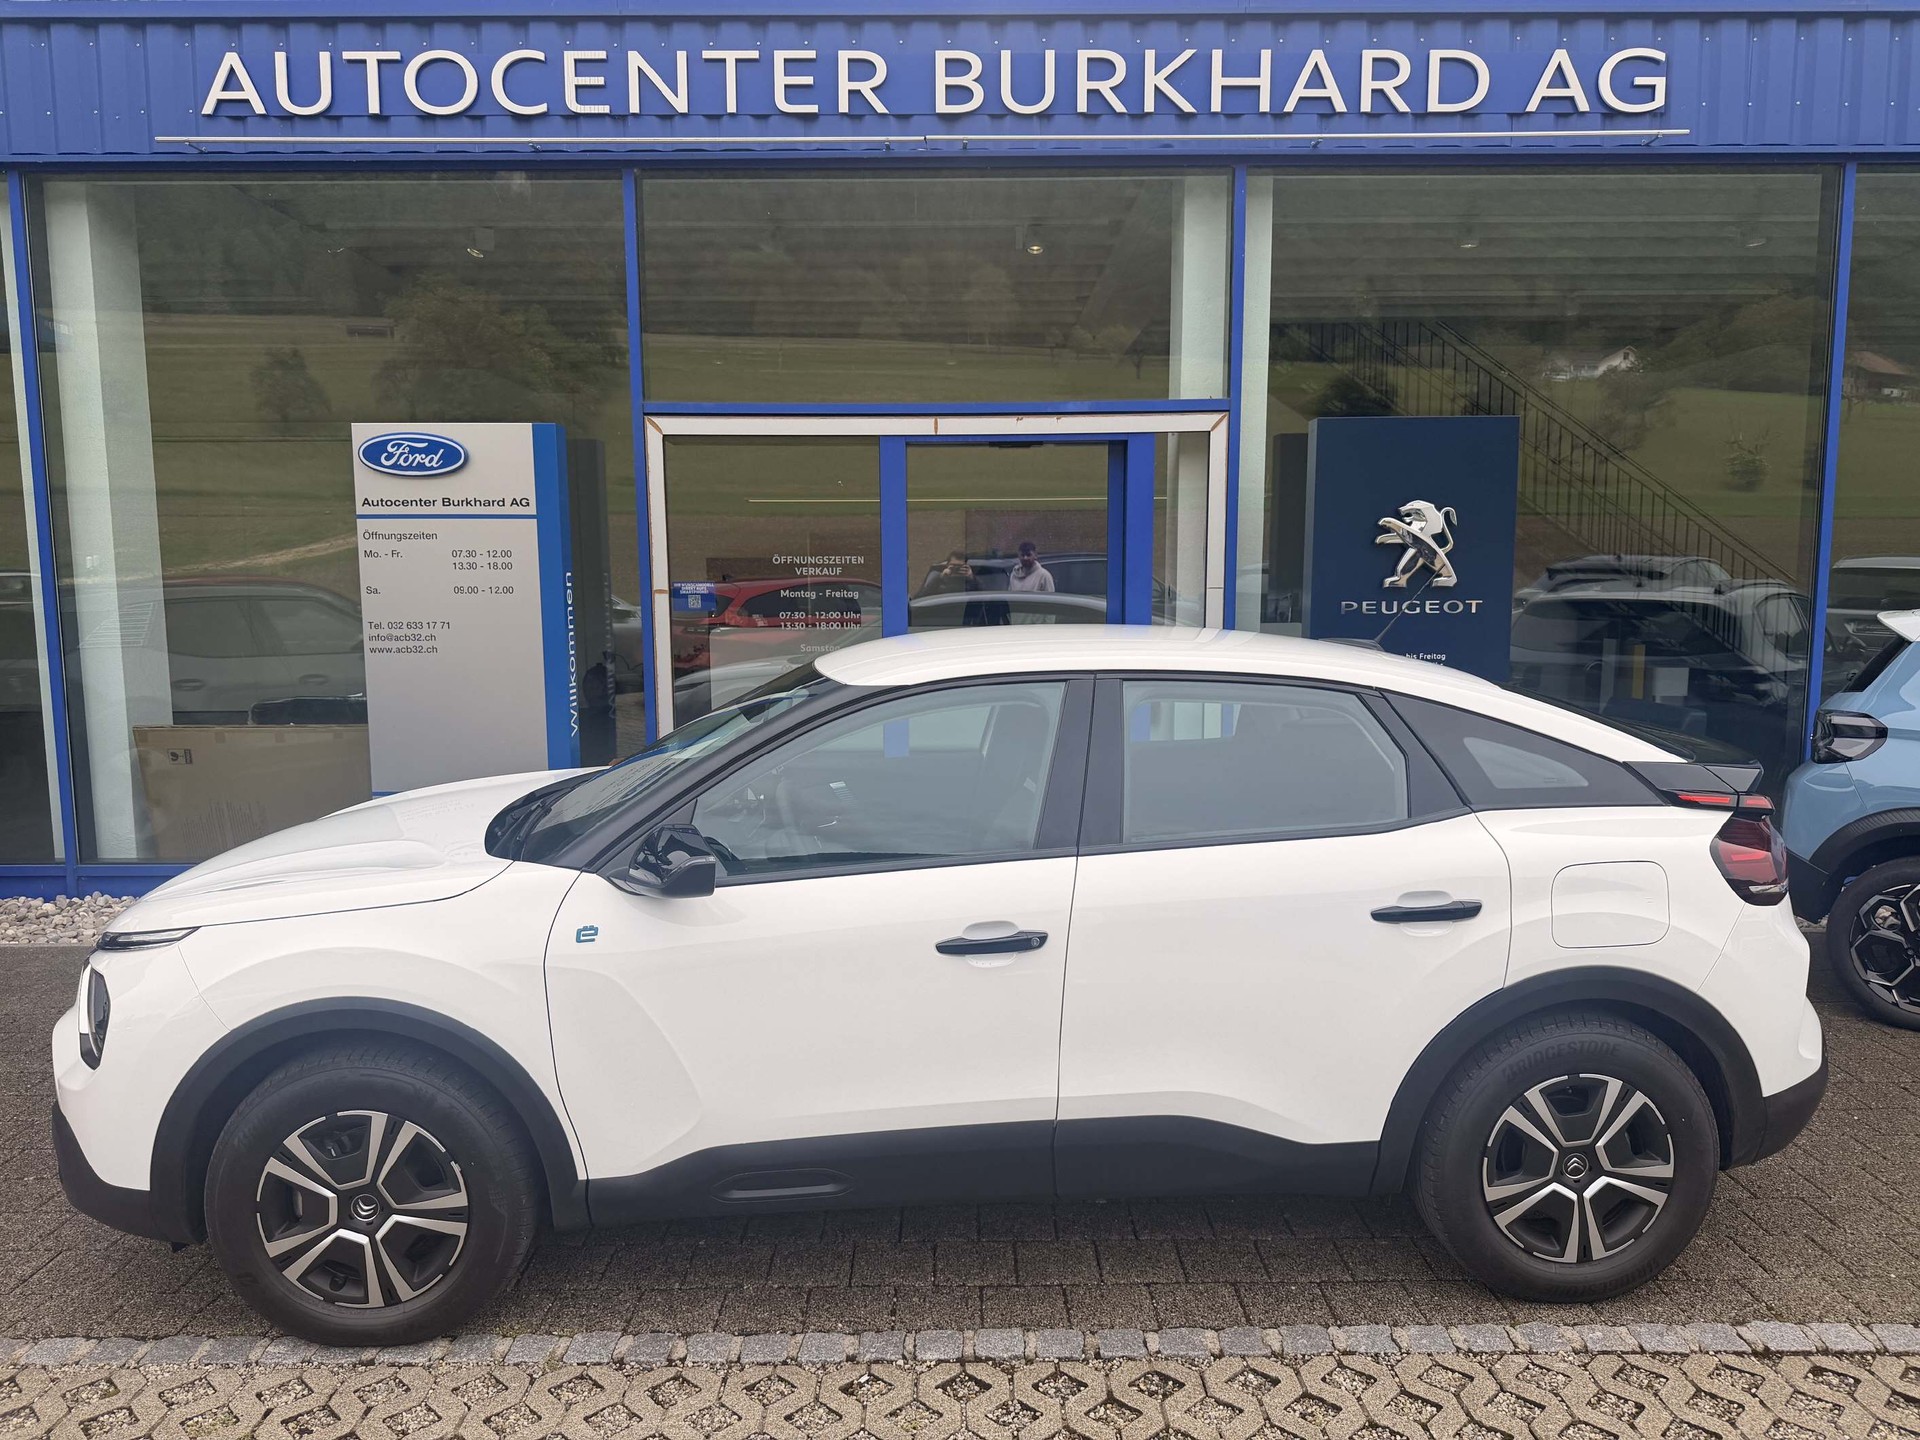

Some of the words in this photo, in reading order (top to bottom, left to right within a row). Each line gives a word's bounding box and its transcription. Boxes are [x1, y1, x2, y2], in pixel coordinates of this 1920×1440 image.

[201, 49, 890, 116] AUTOCENTER
[935, 48, 1491, 115] BURKHARD
[1525, 47, 1667, 114] AG
[381, 440, 445, 468] Ford
[362, 497, 438, 508] Autocenter
[442, 497, 506, 508] Burkhard
[510, 497, 531, 508] AG
[363, 529, 438, 542] Öffnungszeiten
[363, 550, 382, 558] Mo.
[391, 550, 403, 558] Fr.
[451, 550, 477, 558] 07.30
[487, 550, 513, 558] 12.00
[772, 554, 864, 565] ÖFFNUNGSZEITEN
[453, 562, 478, 571] 13.30
[487, 562, 513, 570] 18.00
[795, 567, 842, 576] VERKAUF
[365, 586, 381, 595] Sa.
[453, 586, 479, 595] 09.00
[488, 586, 514, 595] 12.00
[780, 589, 816, 599] Montag
[825, 589, 859, 599] Freitag
[1340, 600, 1484, 615] PEUGEOT
[779, 611, 806, 620] 07:30
[815, 611, 841, 620] 12:00
[843, 611, 861, 620] Uhr
[368, 621, 385, 630] Tel.
[387, 621, 404, 630] 032
[406, 621, 424, 630] 633
[427, 621, 438, 630] 17
[440, 621, 451, 630] 71
[781, 622, 806, 630] 13:30
[815, 622, 841, 630] 18:00
[843, 622, 861, 630] Uhr
[368, 633, 437, 642] info@acb32.ch
[369, 646, 438, 654] www.acb32.ch
[565, 571, 579, 737] Willkommen
[1419, 653, 1446, 661] Freitag
[1501, 1040, 1622, 1082] BRIDGESTONE
